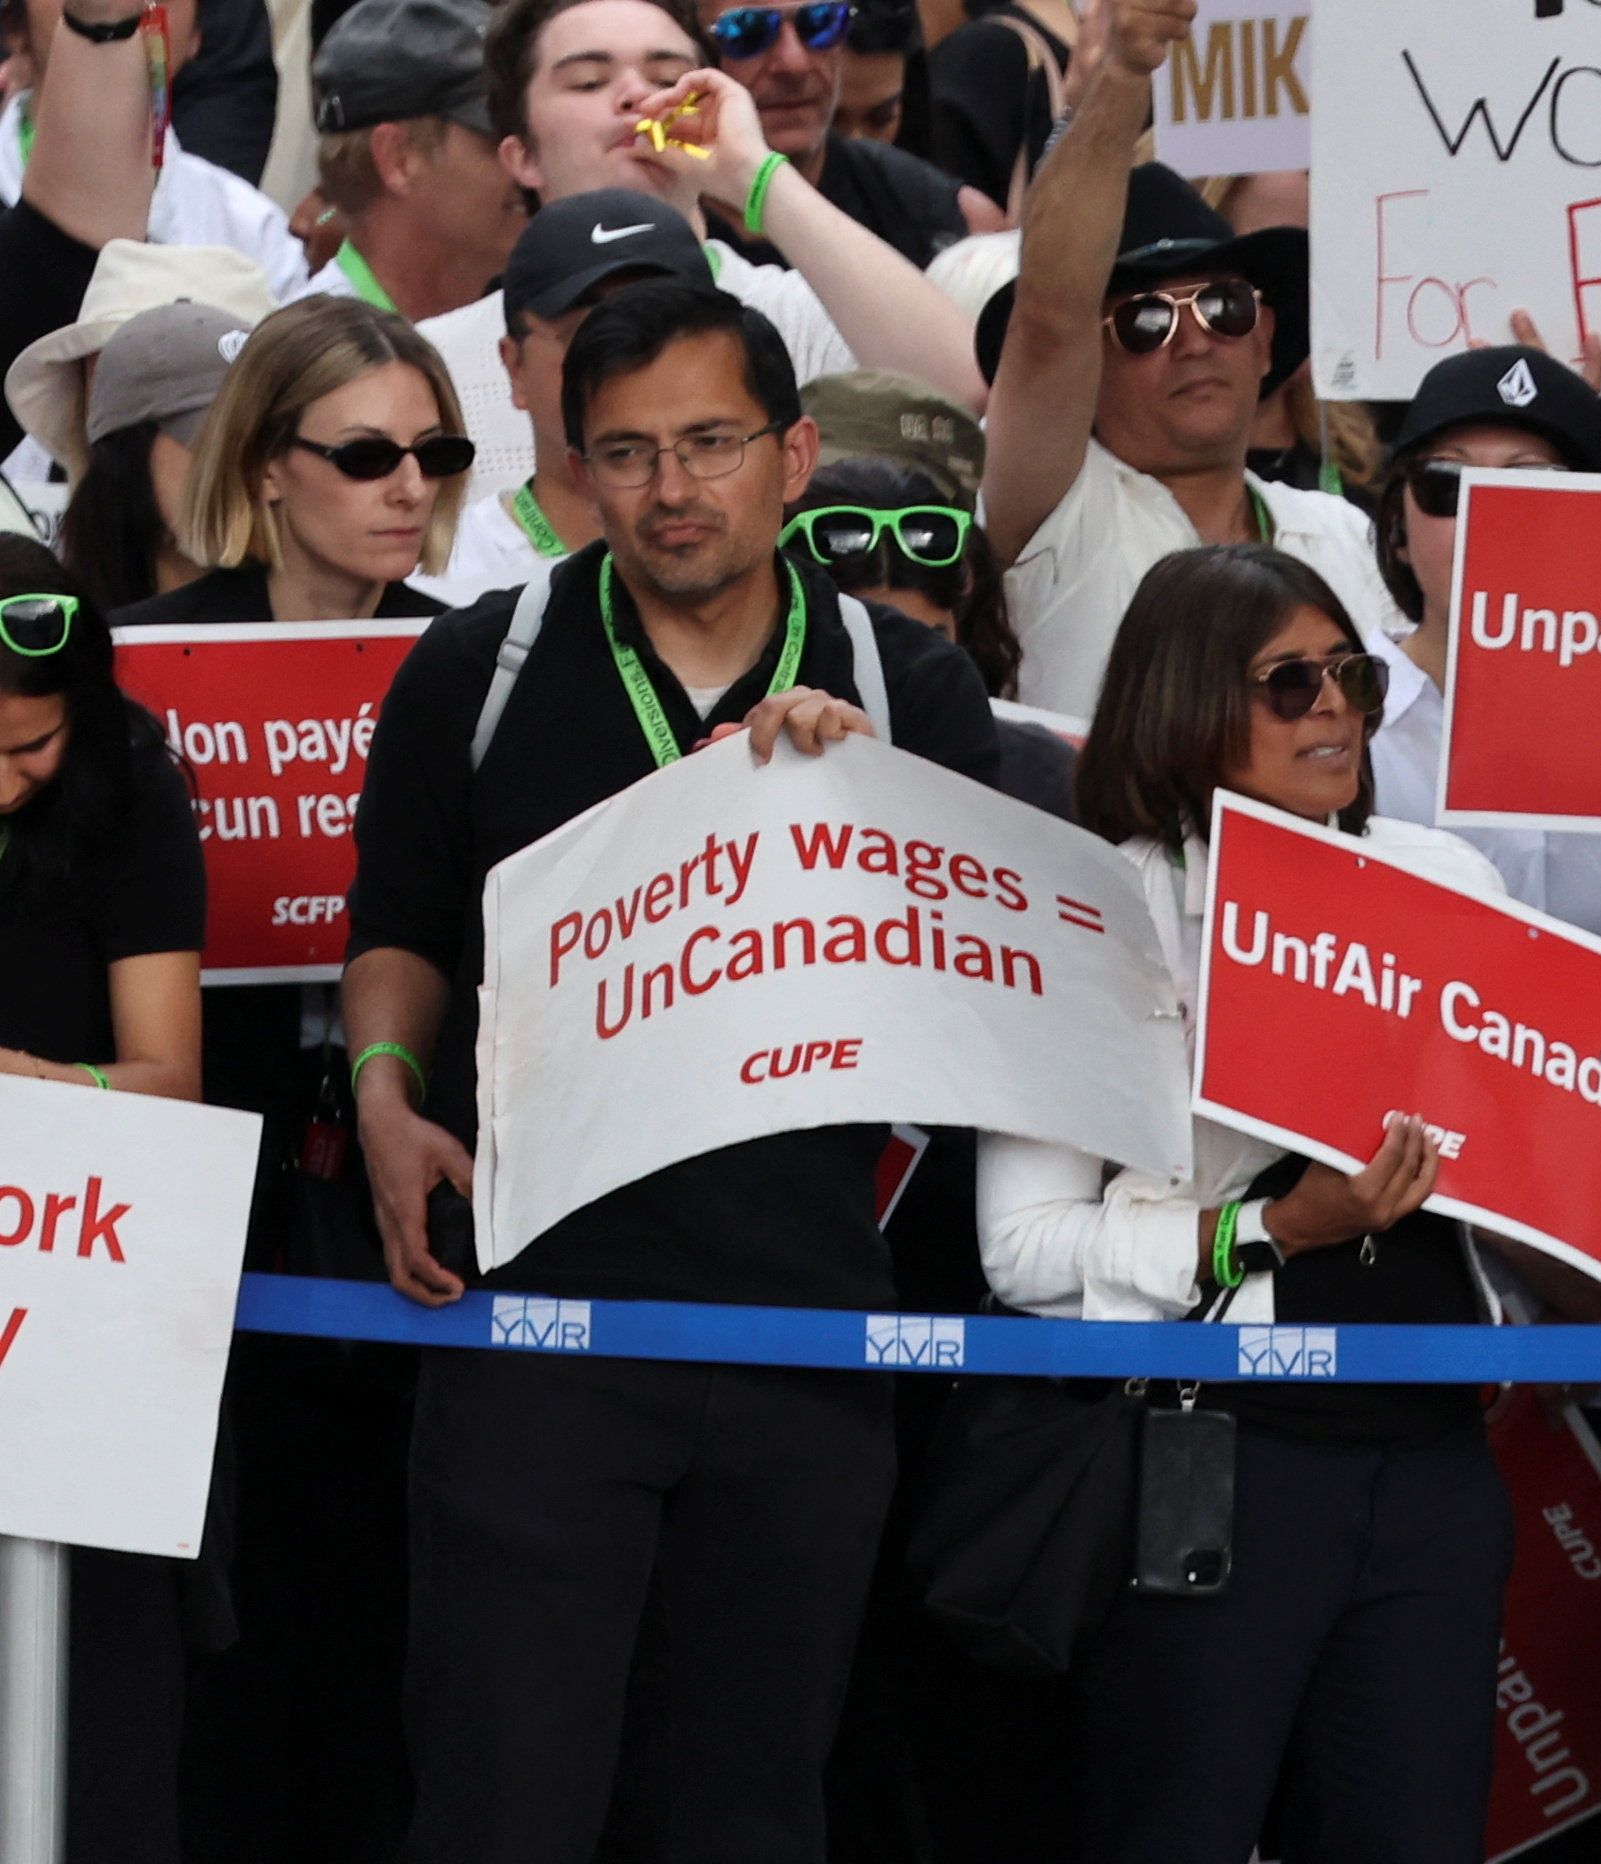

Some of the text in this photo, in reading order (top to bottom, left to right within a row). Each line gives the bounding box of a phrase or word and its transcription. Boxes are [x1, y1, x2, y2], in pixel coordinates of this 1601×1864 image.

[1376, 188, 1497, 361] For
[271, 894, 346, 926] SCFP
[549, 831, 760, 988] Poverty
[788, 821, 1029, 913] wages
[593, 905, 1044, 1041] UnCanadian
[1220, 900, 1423, 1020] UnfAir
[738, 1037, 864, 1085] CUPE
[491, 1311, 589, 1350] YVR
[1238, 1342, 1336, 1376] YVR
